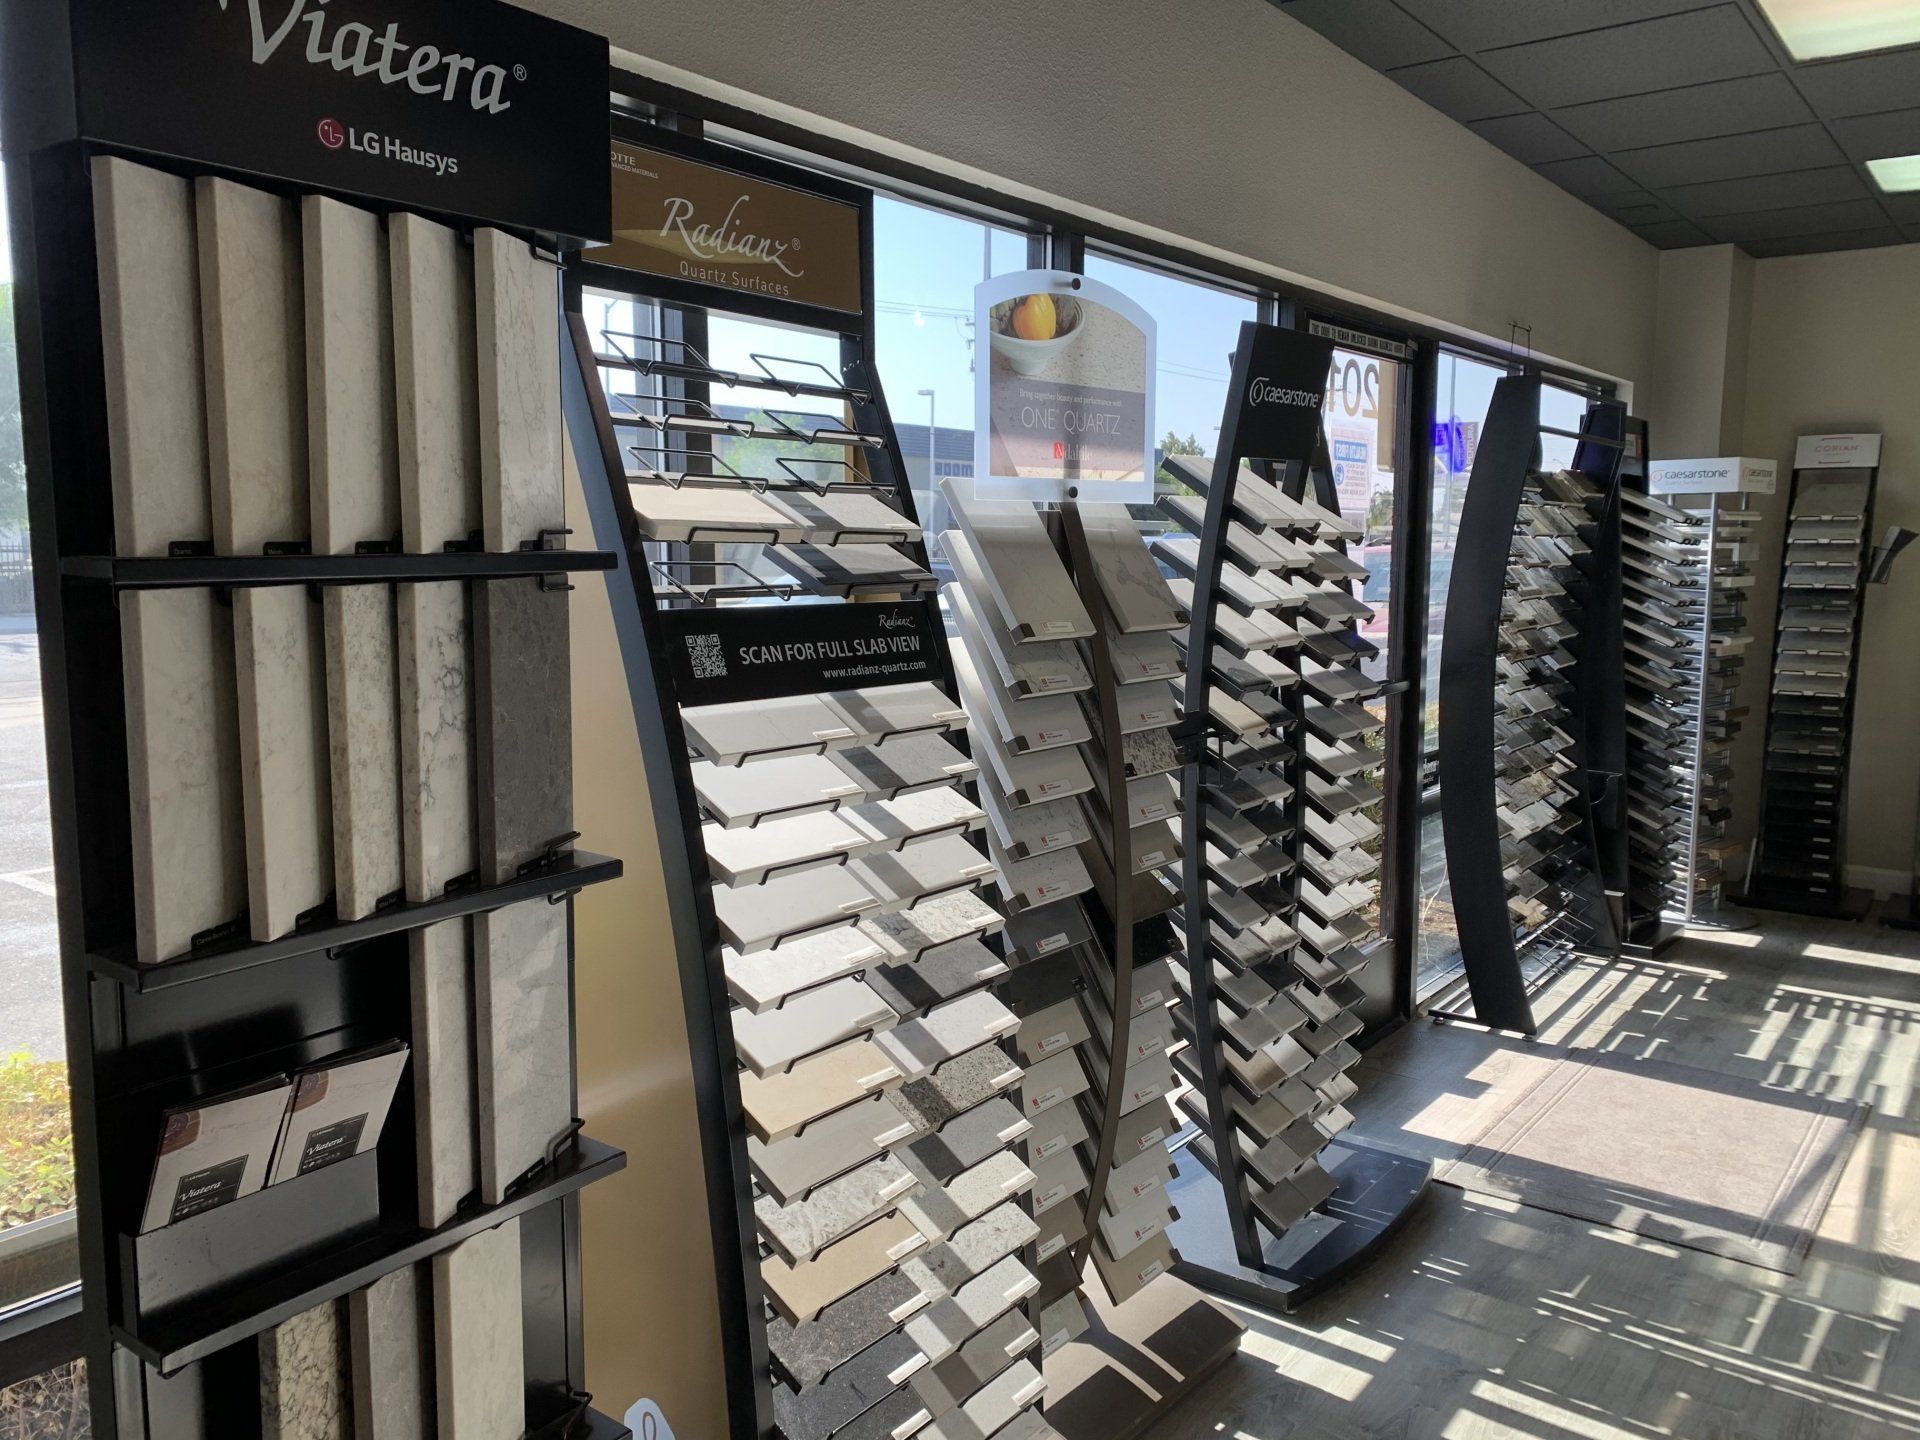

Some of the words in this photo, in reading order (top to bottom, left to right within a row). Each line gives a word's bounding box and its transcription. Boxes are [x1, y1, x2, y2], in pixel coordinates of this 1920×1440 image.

[349, 127, 380, 155] LG
[384, 136, 459, 176] Hausys
[680, 260, 727, 284] Quartz
[732, 271, 790, 297] Surfaces
[1264, 386, 1319, 408] caesarstone
[1021, 406, 1056, 430] ONE
[1063, 410, 1121, 435] QUARTZ
[1815, 444, 1859, 453] CORIAN
[1664, 468, 1729, 480] caesarstone
[739, 645, 784, 665] SCAN
[785, 643, 816, 662] FOR
[819, 640, 853, 659] FULL
[853, 637, 888, 656] SLAB
[887, 635, 920, 654] VIEW
[822, 660, 926, 679] www.radianz-quartz.com
[307, 1137, 344, 1156] Viatera
[179, 1181, 222, 1202] Viatera
